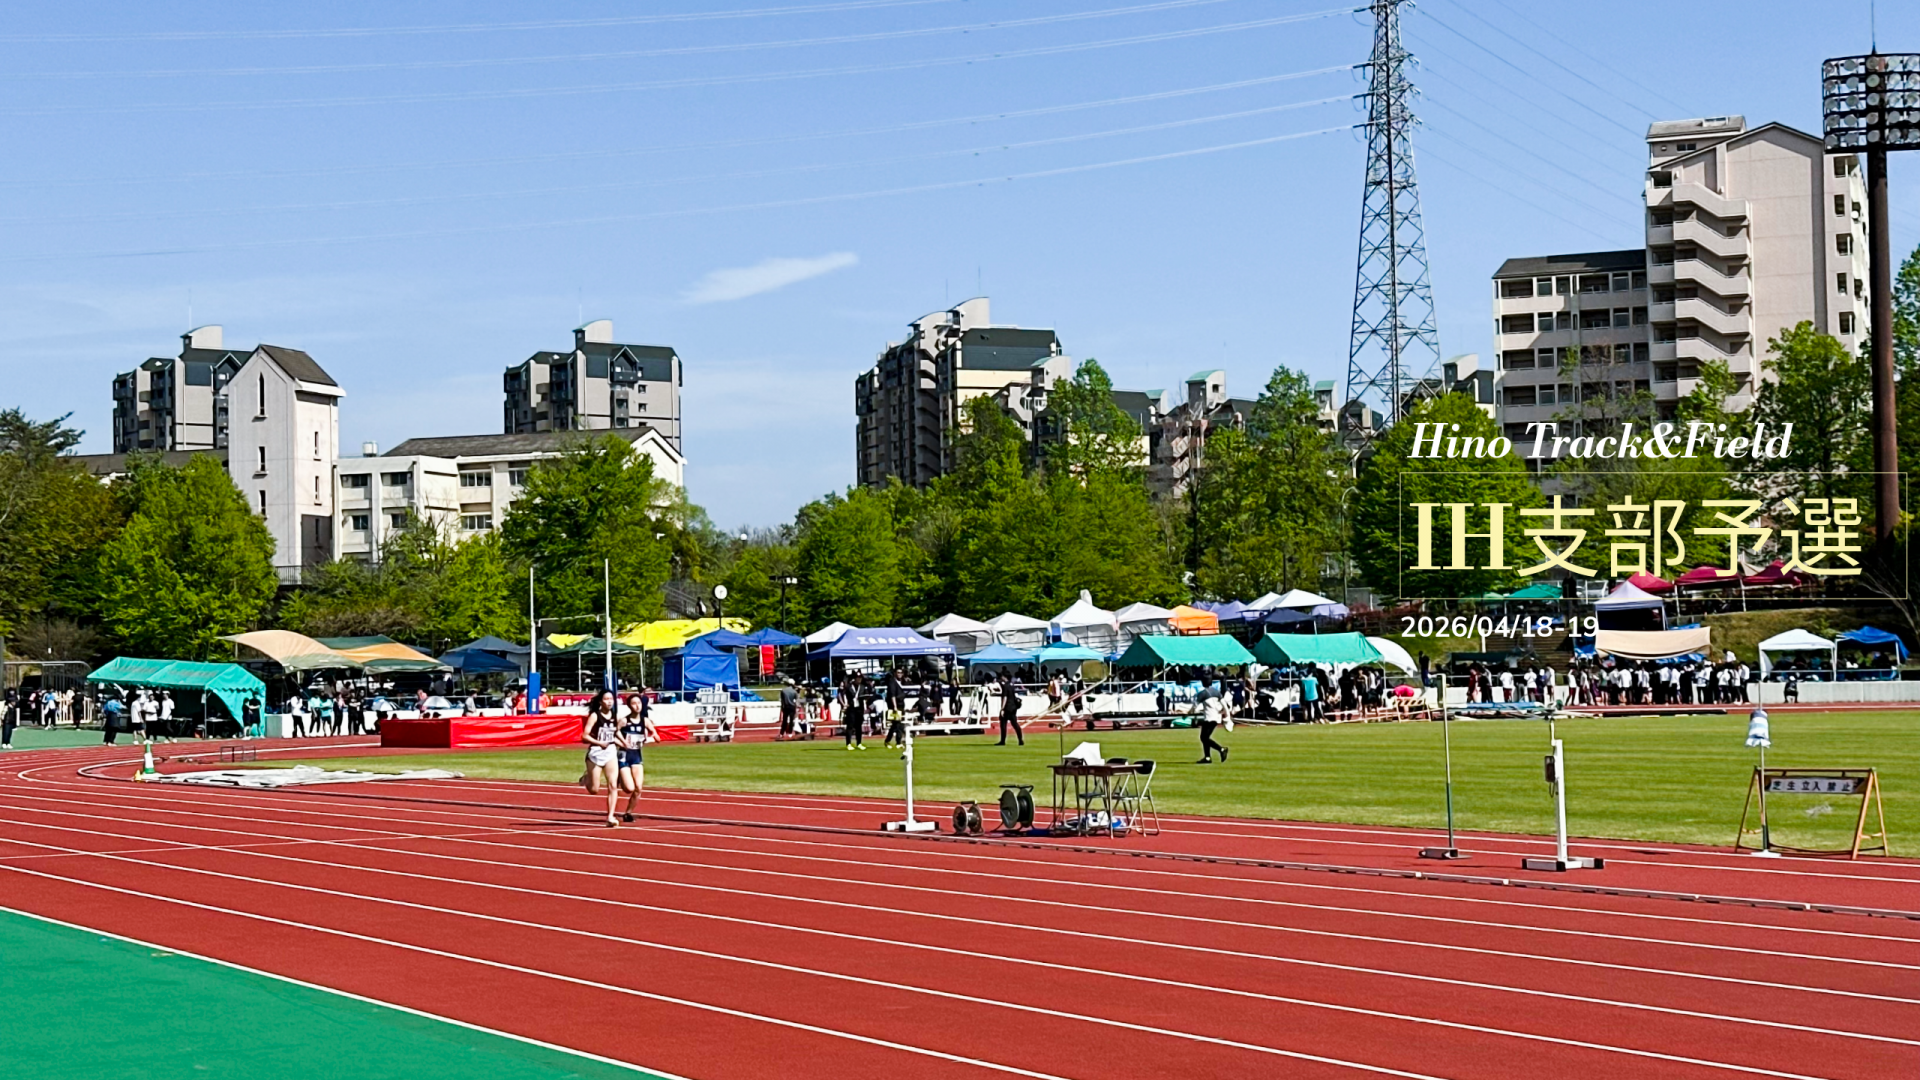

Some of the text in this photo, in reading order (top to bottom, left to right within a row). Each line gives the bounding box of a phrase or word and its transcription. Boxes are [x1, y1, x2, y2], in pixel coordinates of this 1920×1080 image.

[702, 706, 727, 716] 3.710
[1772, 780, 1850, 792] 芝生立入禁止
